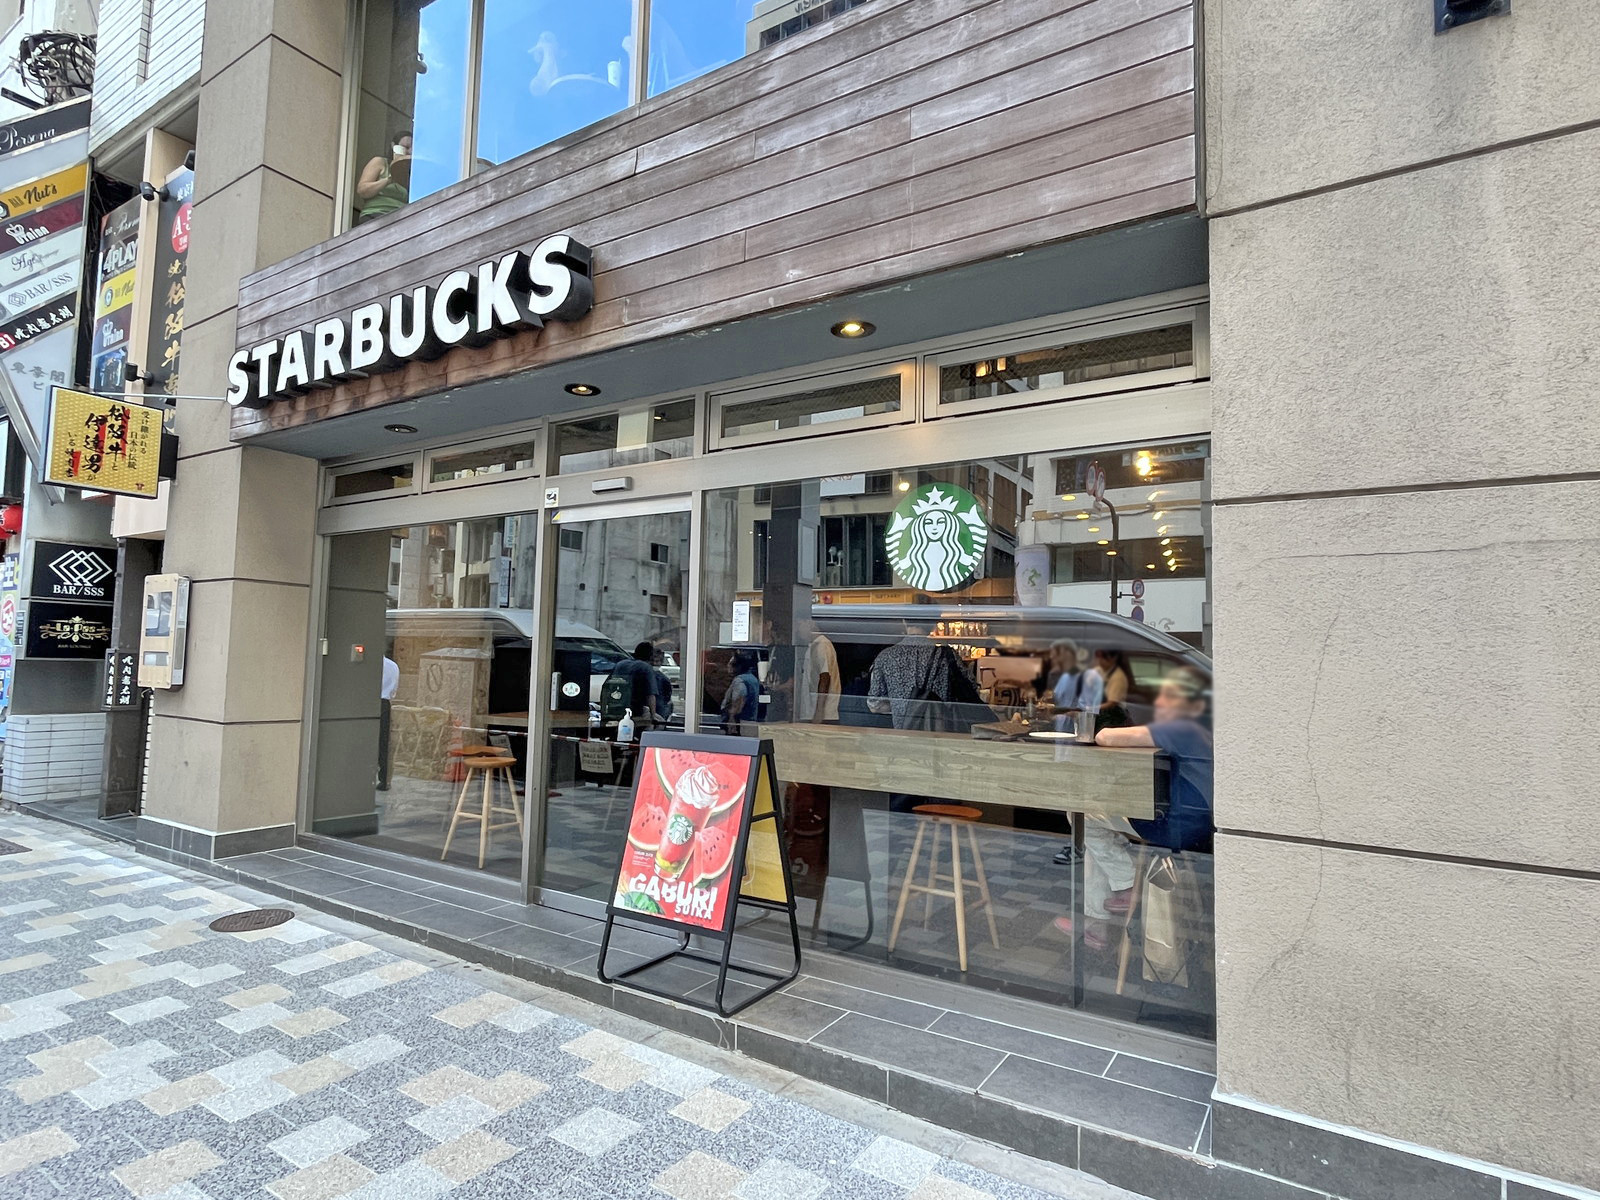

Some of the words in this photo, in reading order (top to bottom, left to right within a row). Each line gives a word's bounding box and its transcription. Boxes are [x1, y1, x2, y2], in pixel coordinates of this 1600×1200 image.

[0, 125, 55, 151] Persona
[24, 184, 57, 204] Nut's
[24, 272, 73, 299] BAR/SSS
[226, 234, 571, 407] STARBUCKS
[53, 584, 104, 597] BAR/SSS
[629, 872, 718, 912] GABURI
[674, 902, 713, 920] SUIKA
